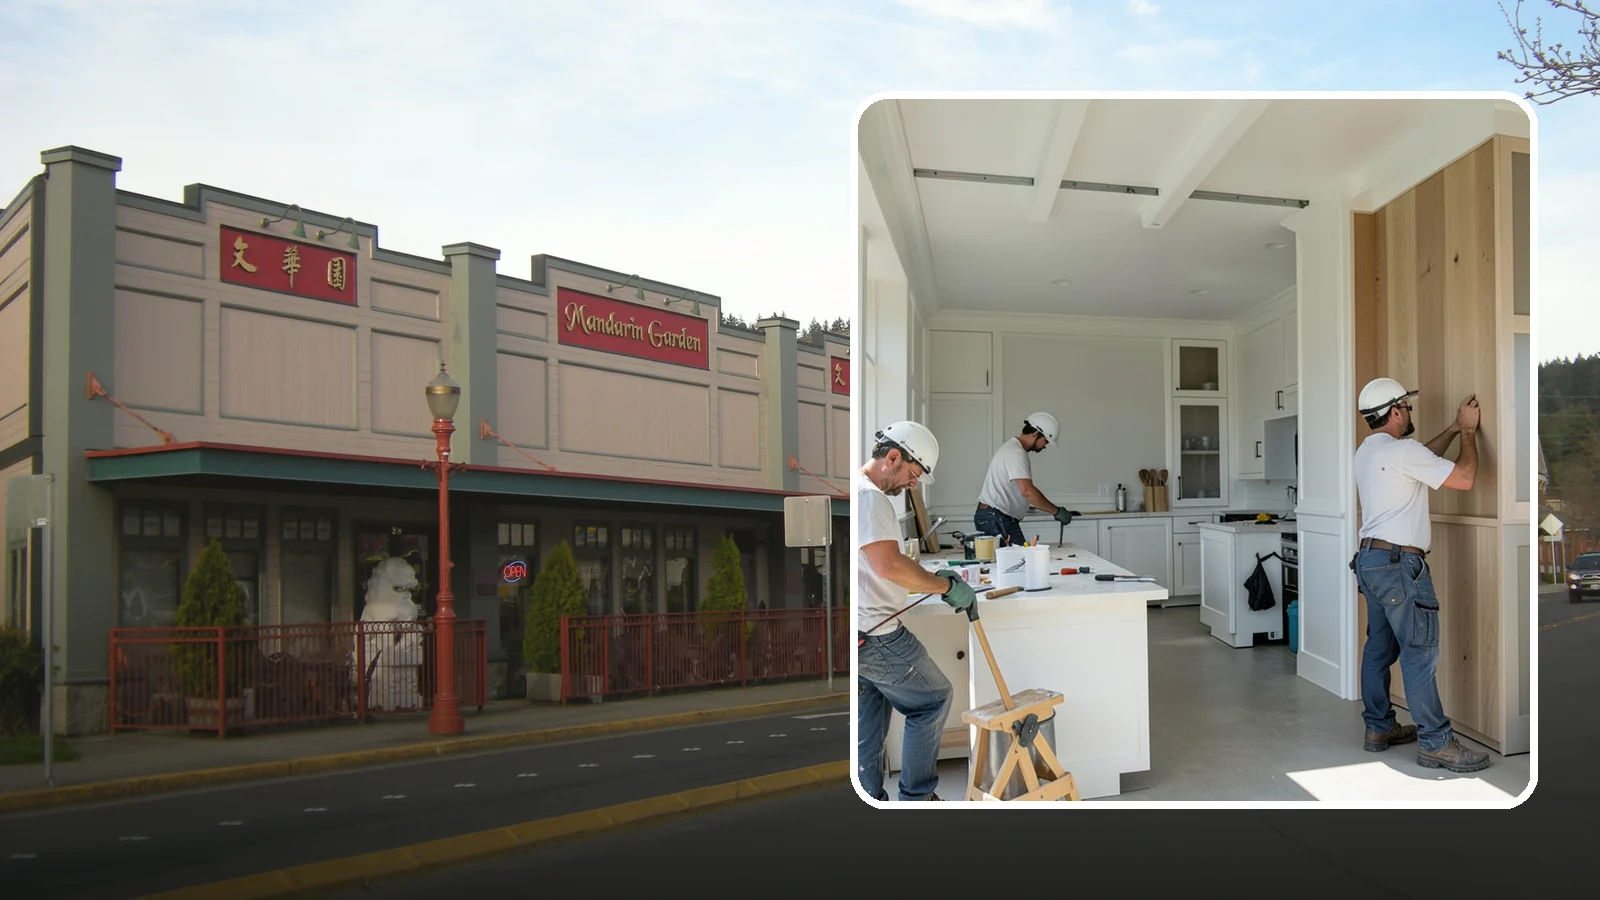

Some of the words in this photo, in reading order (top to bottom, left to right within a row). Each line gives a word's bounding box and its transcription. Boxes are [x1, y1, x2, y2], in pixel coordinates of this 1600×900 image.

[230, 235, 347, 291] 文華園
[564, 302, 644, 340] Mandarin
[648, 320, 702, 351] Garden
[834, 363, 846, 386] 文
[503, 565, 527, 578] OPEN
